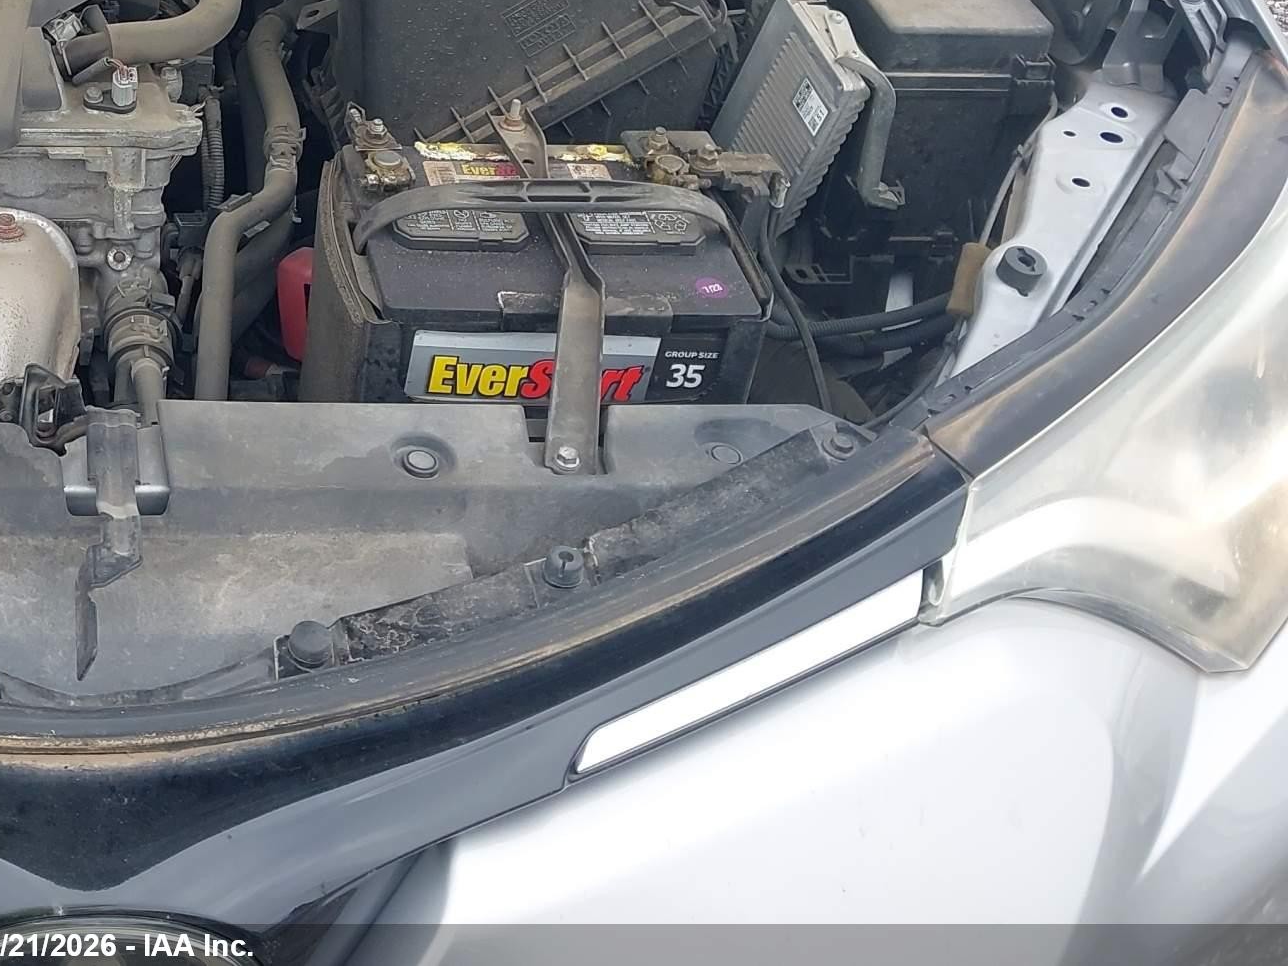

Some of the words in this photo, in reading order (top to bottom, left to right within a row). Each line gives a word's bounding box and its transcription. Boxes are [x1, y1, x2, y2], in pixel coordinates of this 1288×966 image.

[664, 351, 697, 359] GROUP
[426, 355, 644, 402] EverSrt
[666, 363, 706, 388] 35
